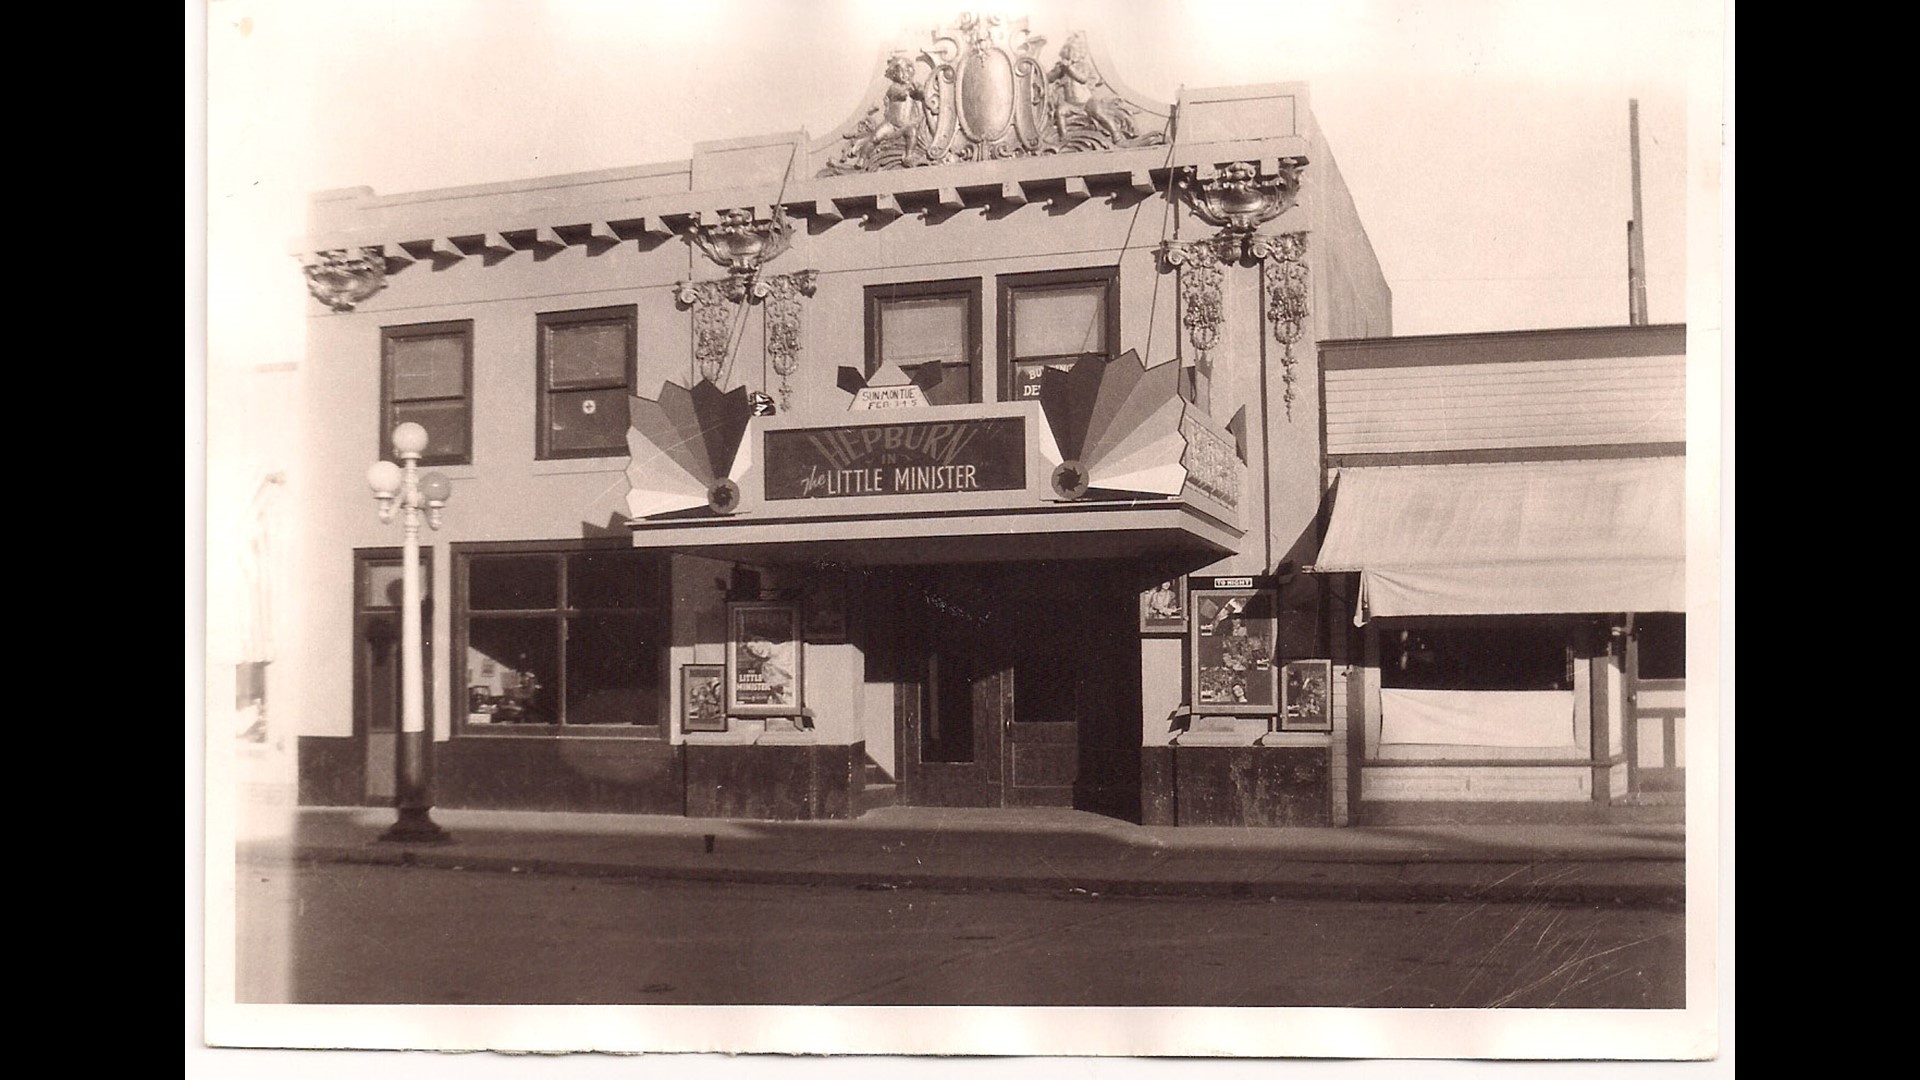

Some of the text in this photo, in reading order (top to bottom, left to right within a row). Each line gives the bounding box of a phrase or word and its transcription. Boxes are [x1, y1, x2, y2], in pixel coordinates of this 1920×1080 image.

[862, 387, 916, 401] SUN MON TUE
[808, 423, 978, 470] HEPBURN
[882, 453, 897, 464] IN
[827, 468, 883, 495] LITTLE
[895, 465, 980, 493] MINISTER
[739, 673, 763, 682] LITTLE
[737, 682, 771, 692] MINISTER
